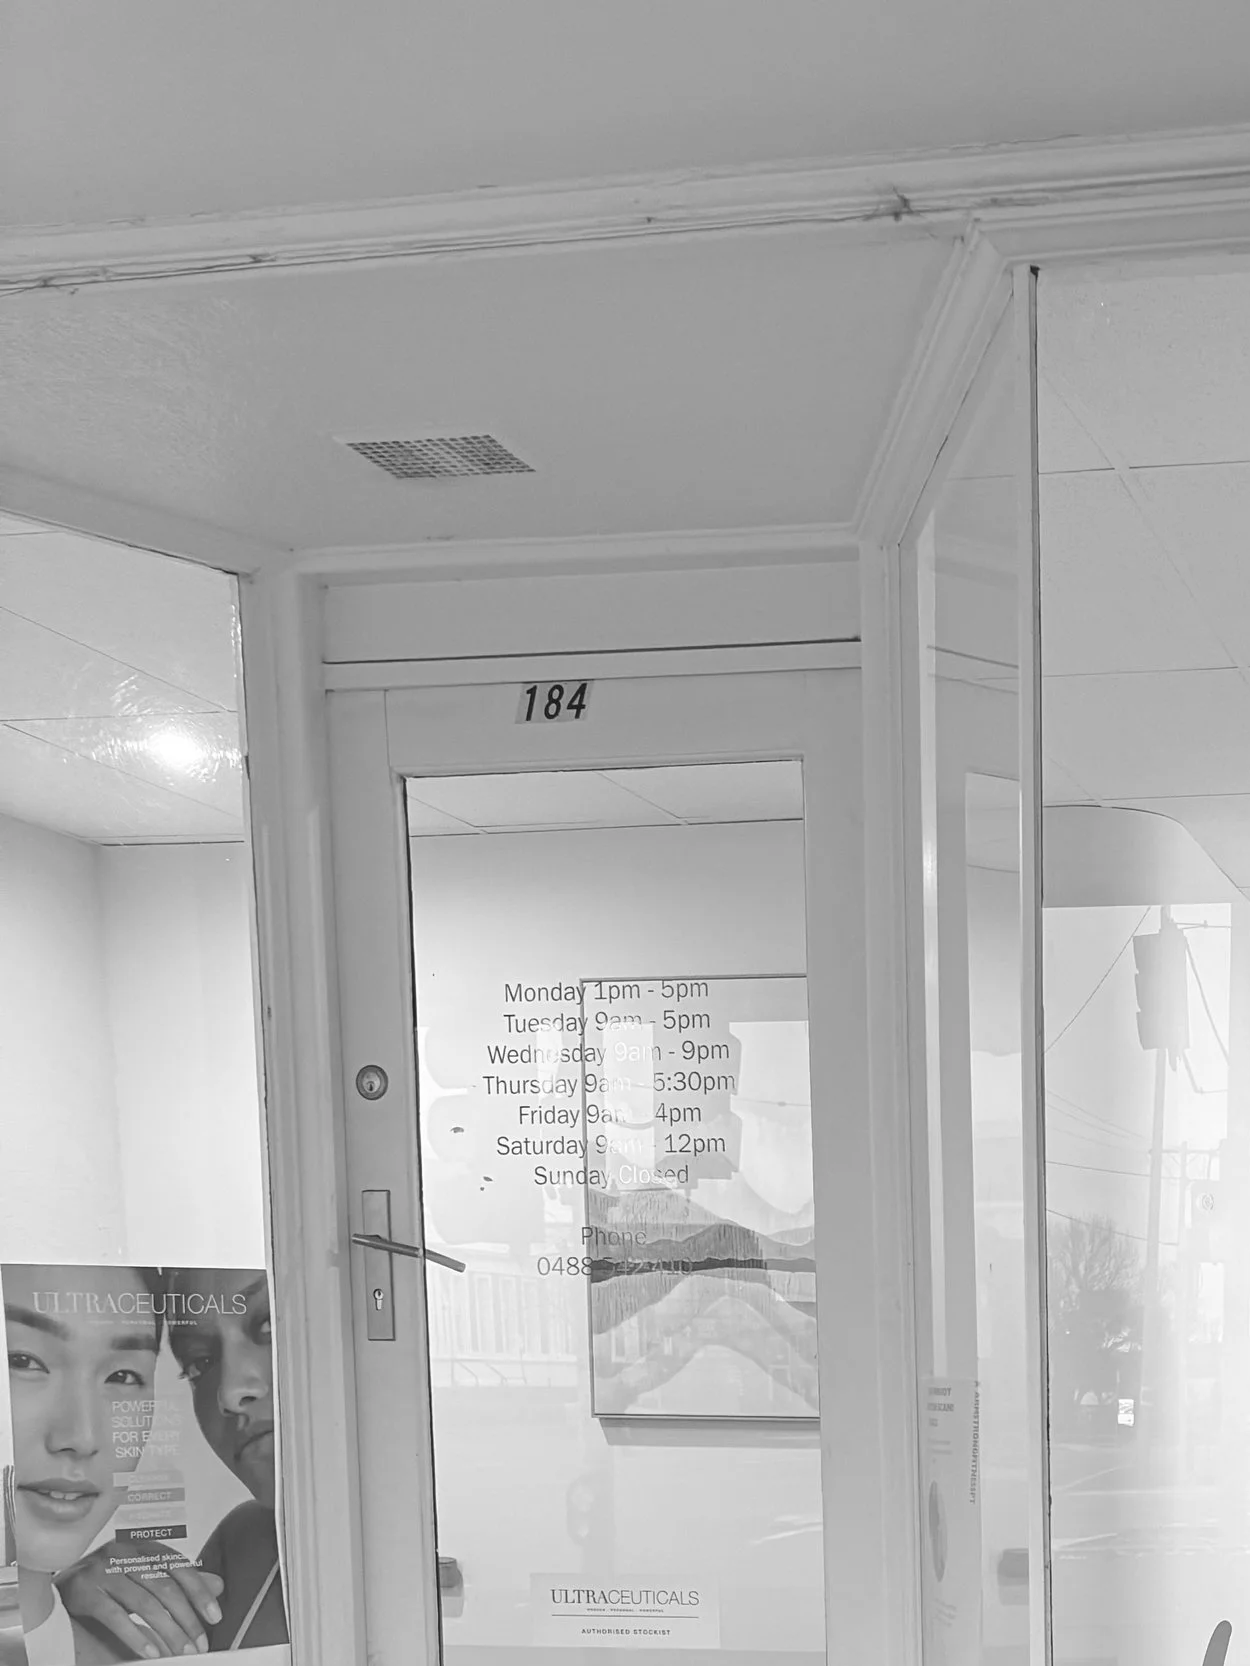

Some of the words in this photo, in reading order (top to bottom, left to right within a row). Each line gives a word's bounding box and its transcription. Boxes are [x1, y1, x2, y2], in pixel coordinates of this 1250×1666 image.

[525, 682, 588, 721] 184
[505, 982, 587, 1005] Monday
[594, 981, 640, 1004] 1pm
[661, 980, 708, 1002] 5pm
[503, 1013, 588, 1036] Tuesday
[595, 1011, 642, 1031] 9am
[663, 1010, 710, 1033] 5pm
[487, 1043, 607, 1066] Wednesday
[614, 1042, 661, 1061] 9am
[681, 1040, 729, 1064] 9pm
[482, 1074, 578, 1097] Thursday
[653, 1071, 736, 1095] 5:30pm
[519, 1105, 580, 1128] Friday
[655, 1102, 701, 1127] 4pm
[496, 1135, 588, 1158] Saturday
[664, 1133, 726, 1157] 12pm
[534, 1165, 610, 1189] Sunday
[619, 1164, 689, 1185] Closed
[581, 1226, 646, 1246] Phone
[537, 1256, 593, 1276] 0488
[32, 1291, 248, 1315] ULTRACEUTICALS
[112, 1431, 139, 1444] FOR
[115, 1446, 145, 1458] SKIN
[130, 1528, 173, 1539] PROTECT
[105, 1566, 122, 1574] with
[124, 1564, 151, 1574] proven
[152, 1561, 168, 1570] and
[169, 1559, 203, 1570] powerful
[110, 1554, 160, 1565] Personalised
[551, 1588, 700, 1606] ULTRACEUTICALS
